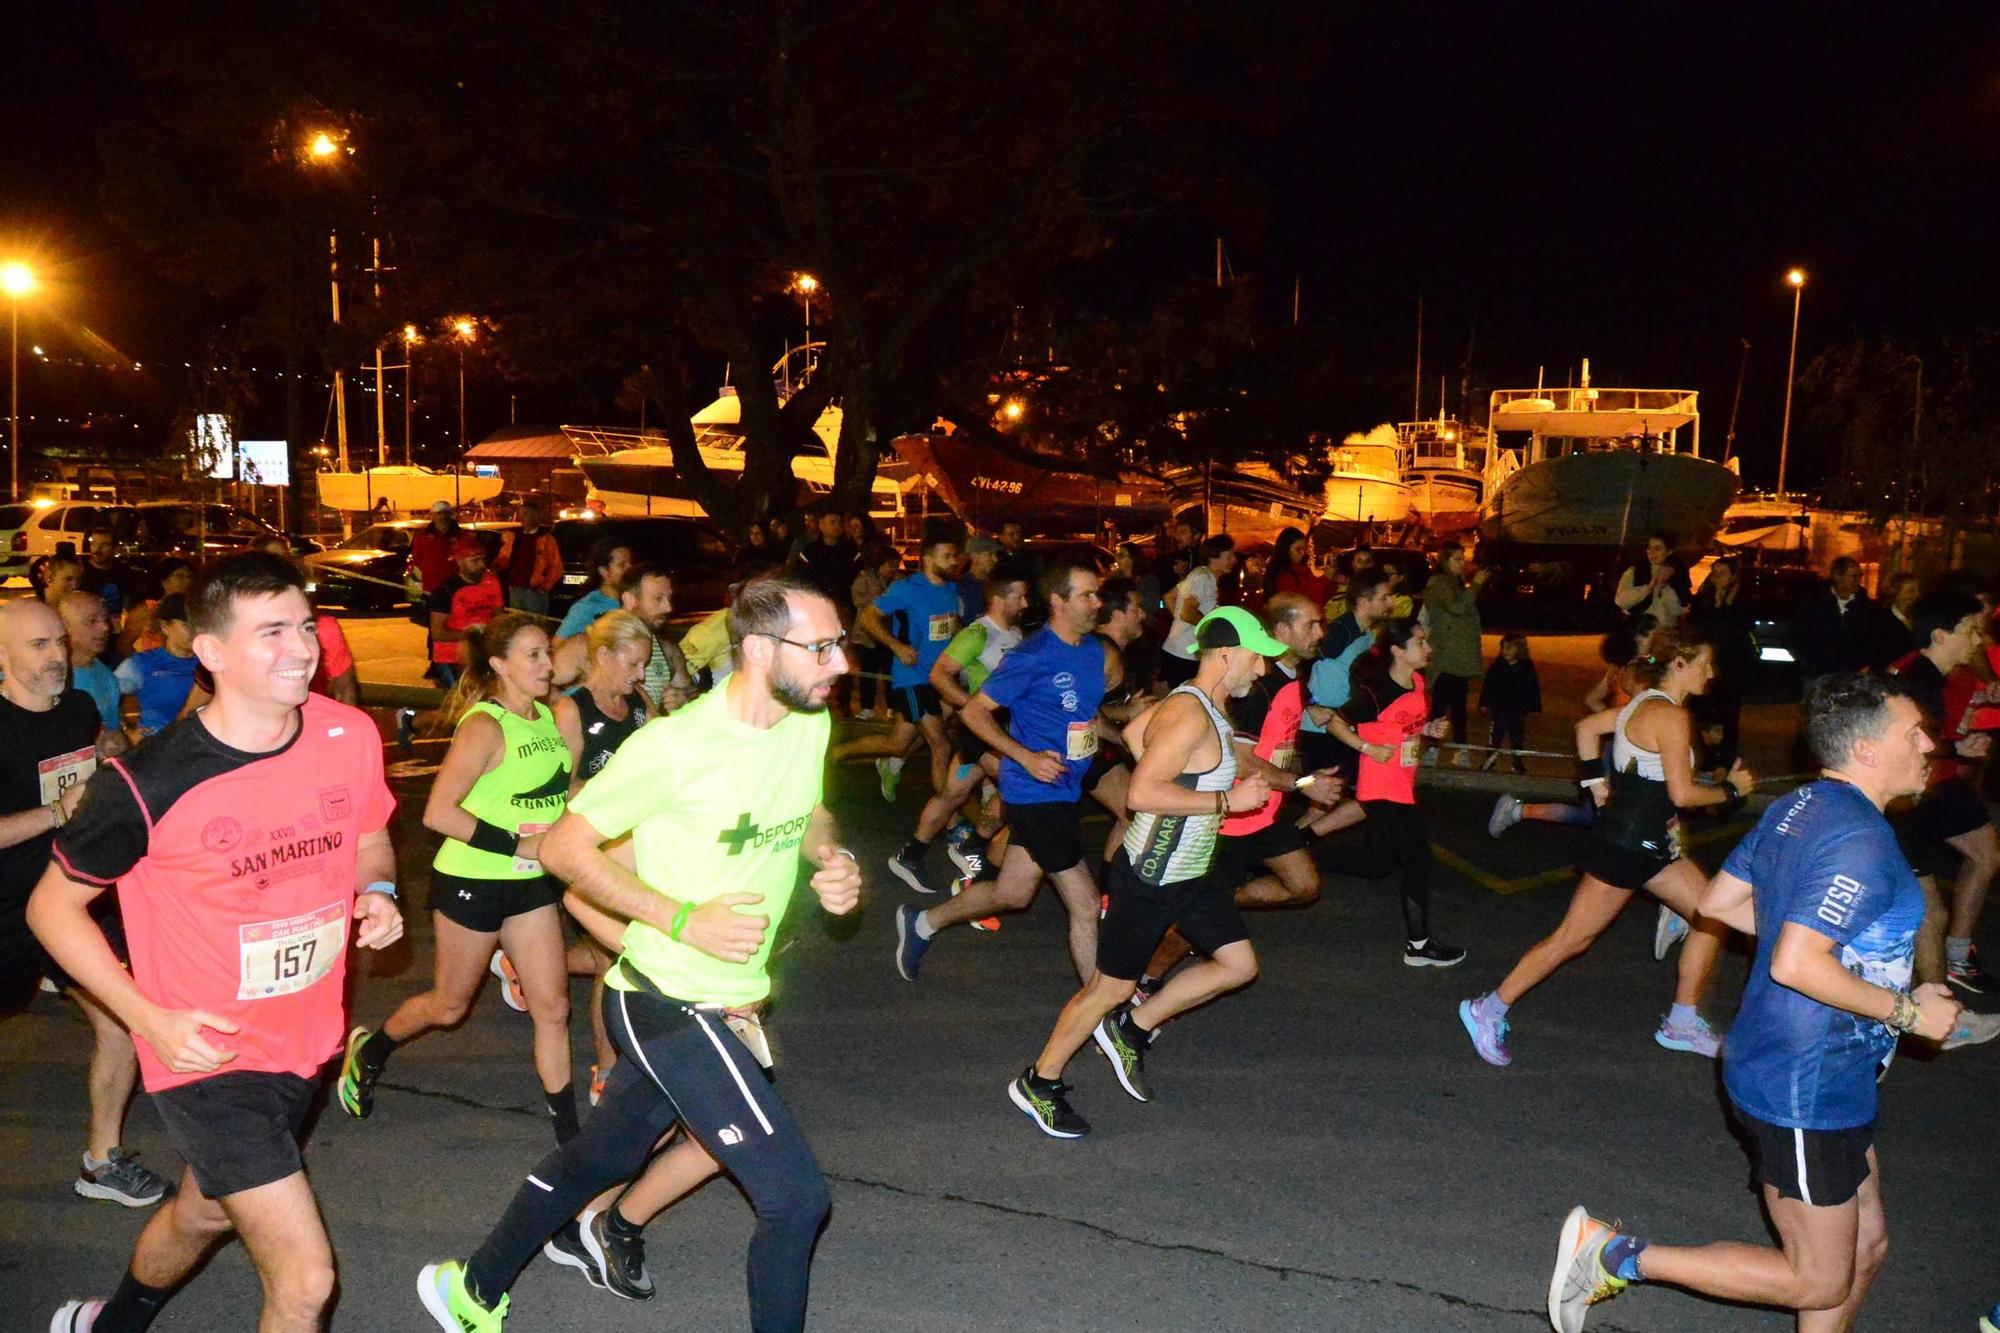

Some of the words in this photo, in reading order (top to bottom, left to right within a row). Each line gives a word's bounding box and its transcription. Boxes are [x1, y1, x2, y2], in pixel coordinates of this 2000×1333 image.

[231, 852, 268, 878] SAN
[271, 831, 343, 867] MARTIÑO
[1816, 874, 1860, 926] OTSO
[274, 939, 318, 982] 157
